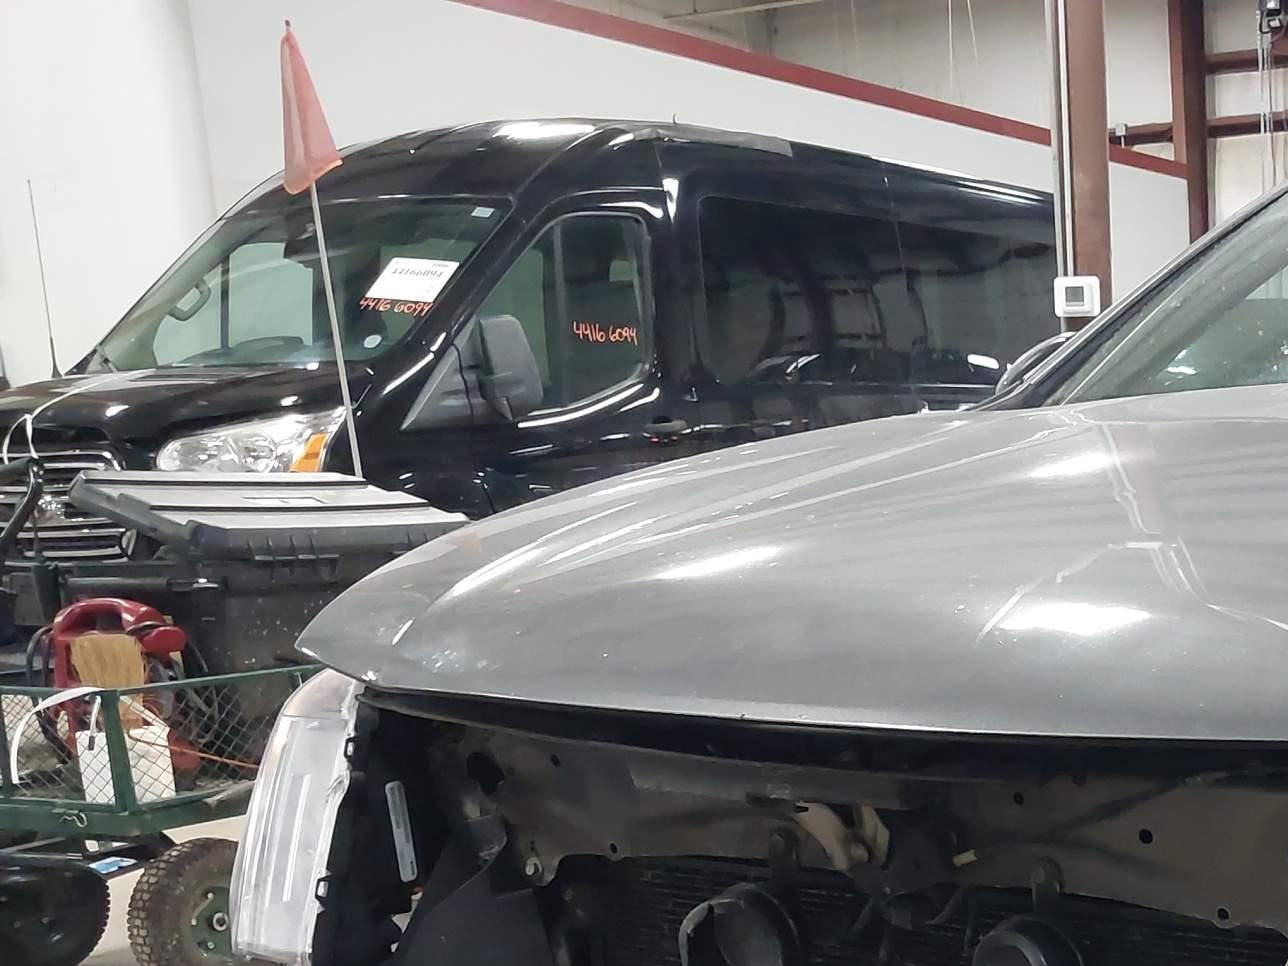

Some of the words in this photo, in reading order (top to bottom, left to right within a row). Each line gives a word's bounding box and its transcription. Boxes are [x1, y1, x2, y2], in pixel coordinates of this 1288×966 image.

[359, 298, 392, 312] 4416
[393, 302, 434, 317] 6094
[572, 320, 606, 342] 4416
[608, 325, 639, 347] 6094
